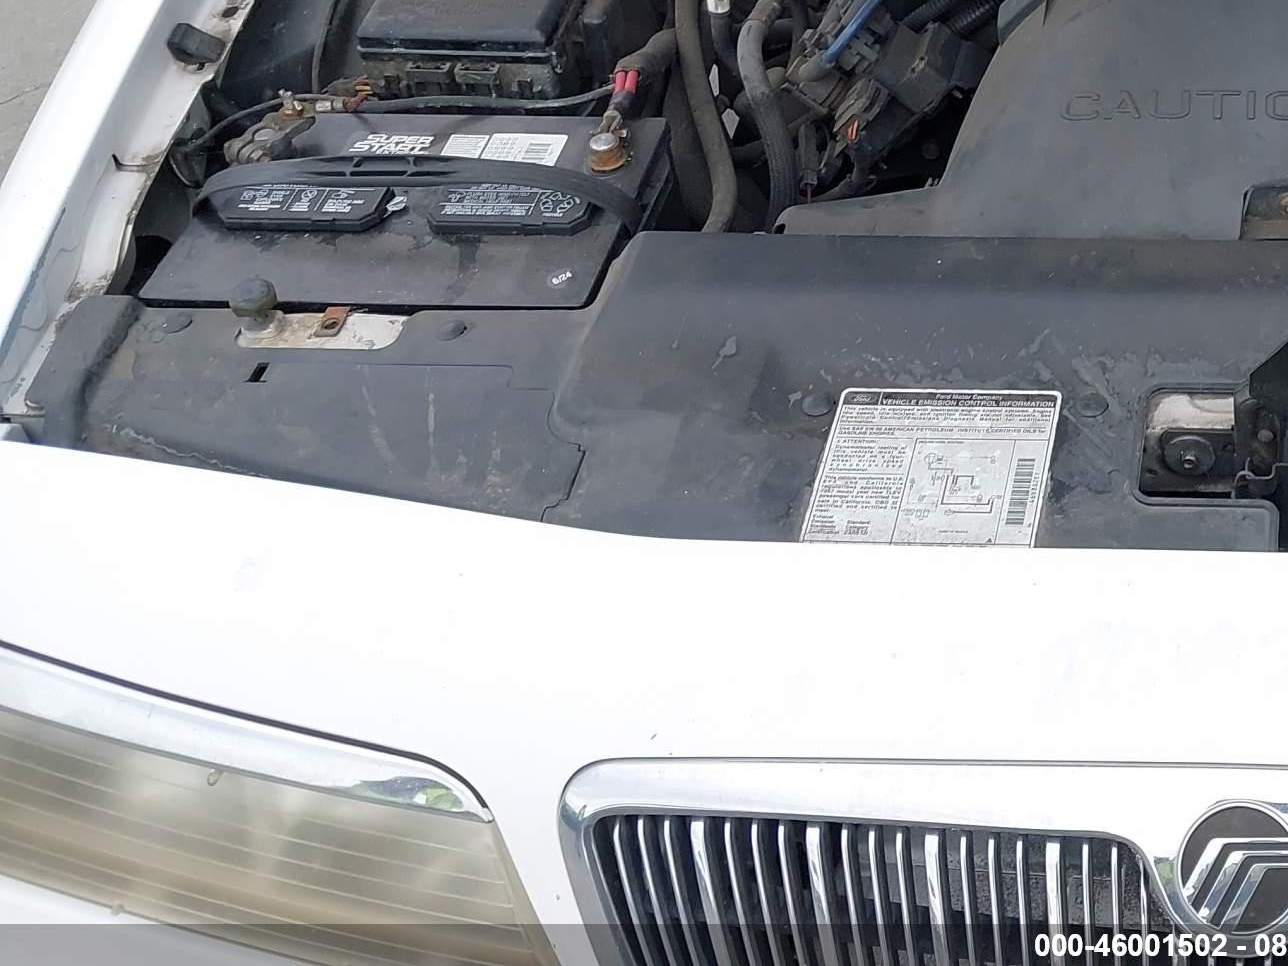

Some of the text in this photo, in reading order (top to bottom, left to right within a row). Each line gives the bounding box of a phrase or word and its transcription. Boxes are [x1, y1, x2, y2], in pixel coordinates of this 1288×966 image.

[366, 133, 436, 144] SUPER
[348, 141, 431, 153] START
[959, 399, 997, 407] CONTROL
